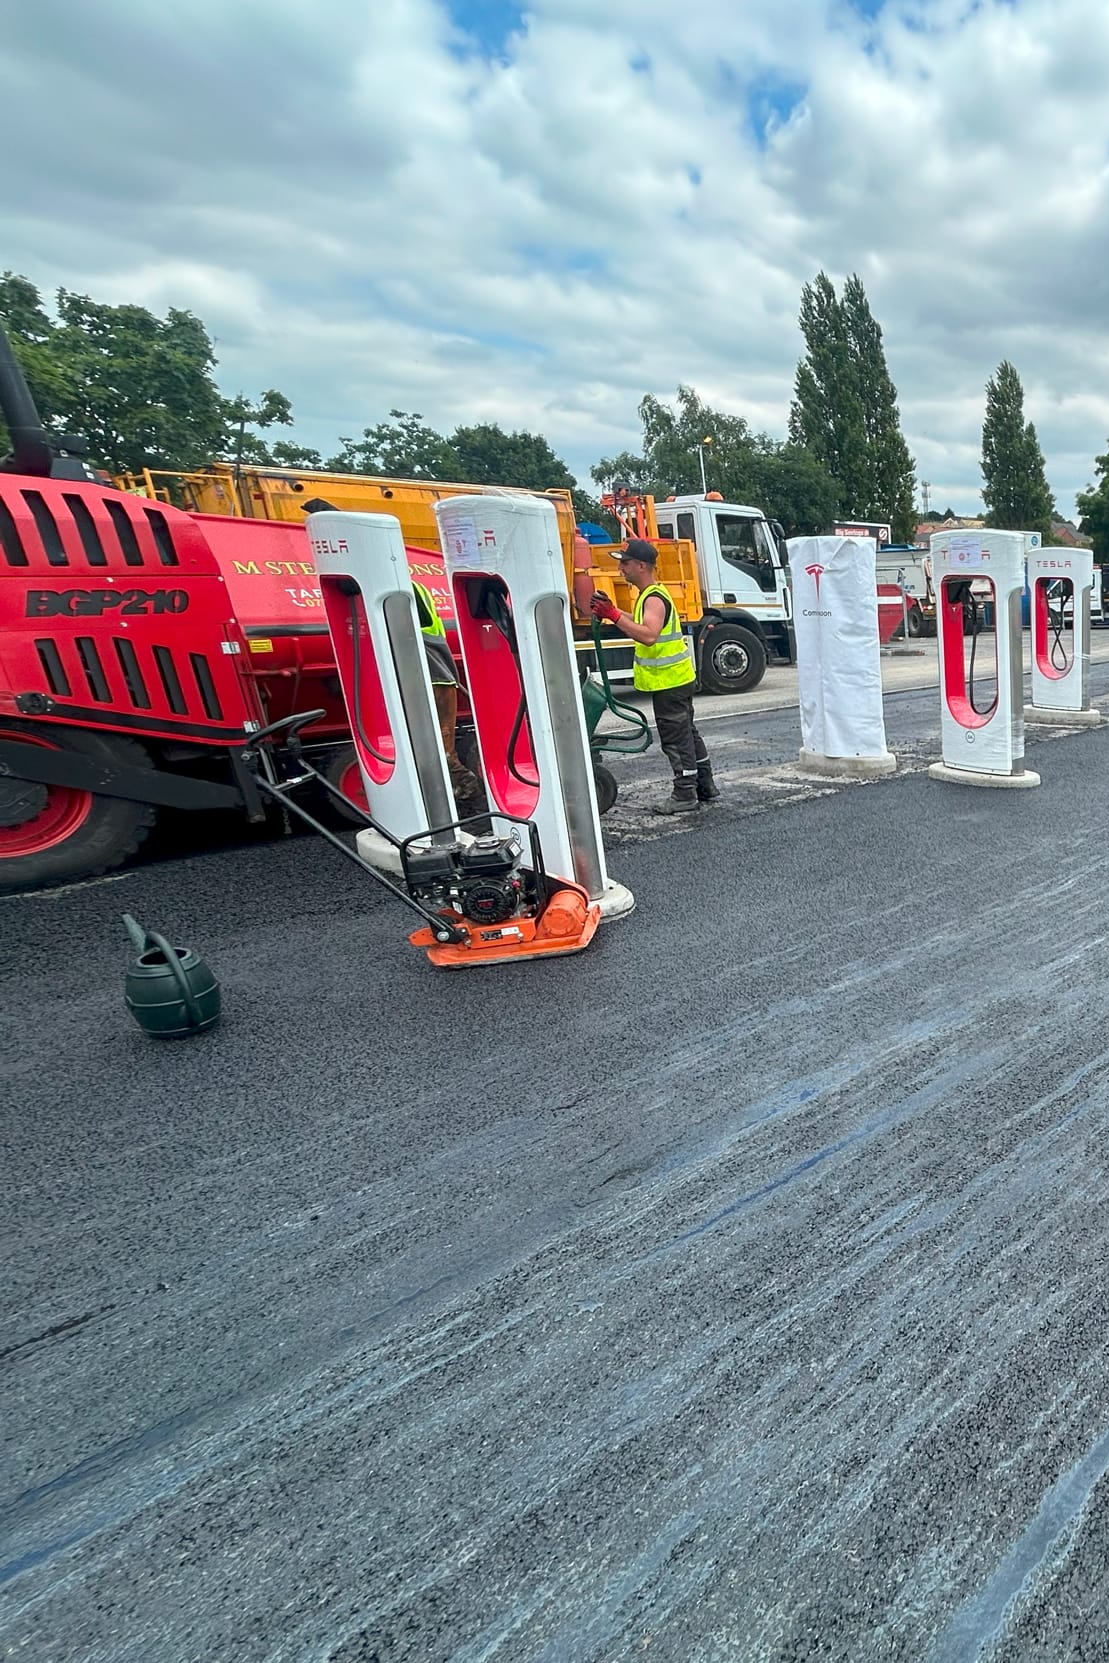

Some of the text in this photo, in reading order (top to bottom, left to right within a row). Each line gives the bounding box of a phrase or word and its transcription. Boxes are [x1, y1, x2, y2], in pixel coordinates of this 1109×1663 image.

[312, 540, 349, 554] ESLA
[232, 560, 262, 576] M
[1036, 560, 1072, 568] TESLA
[25, 589, 190, 618] BGP210
